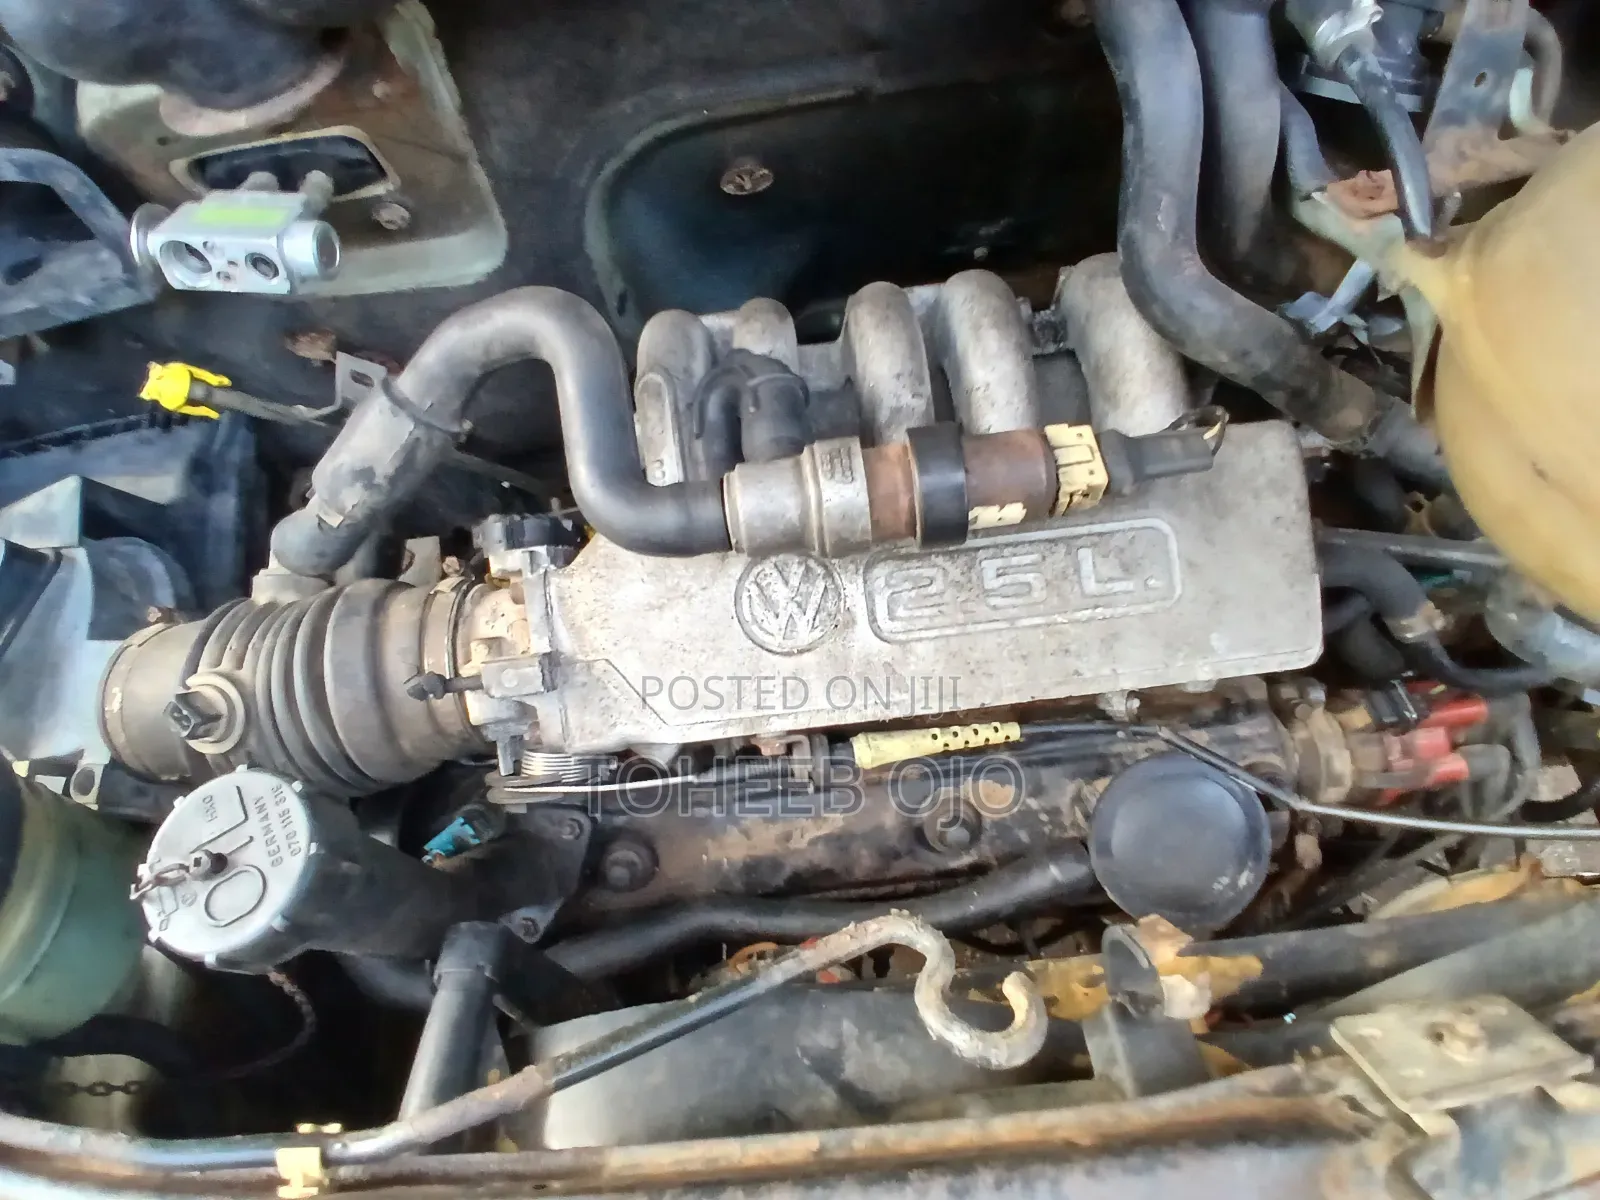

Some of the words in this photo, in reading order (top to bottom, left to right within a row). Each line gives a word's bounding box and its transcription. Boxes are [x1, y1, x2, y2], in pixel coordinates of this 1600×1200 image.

[737, 554, 842, 654] VW
[253, 795, 284, 868] GERMANY
[285, 829, 302, 857] 070
